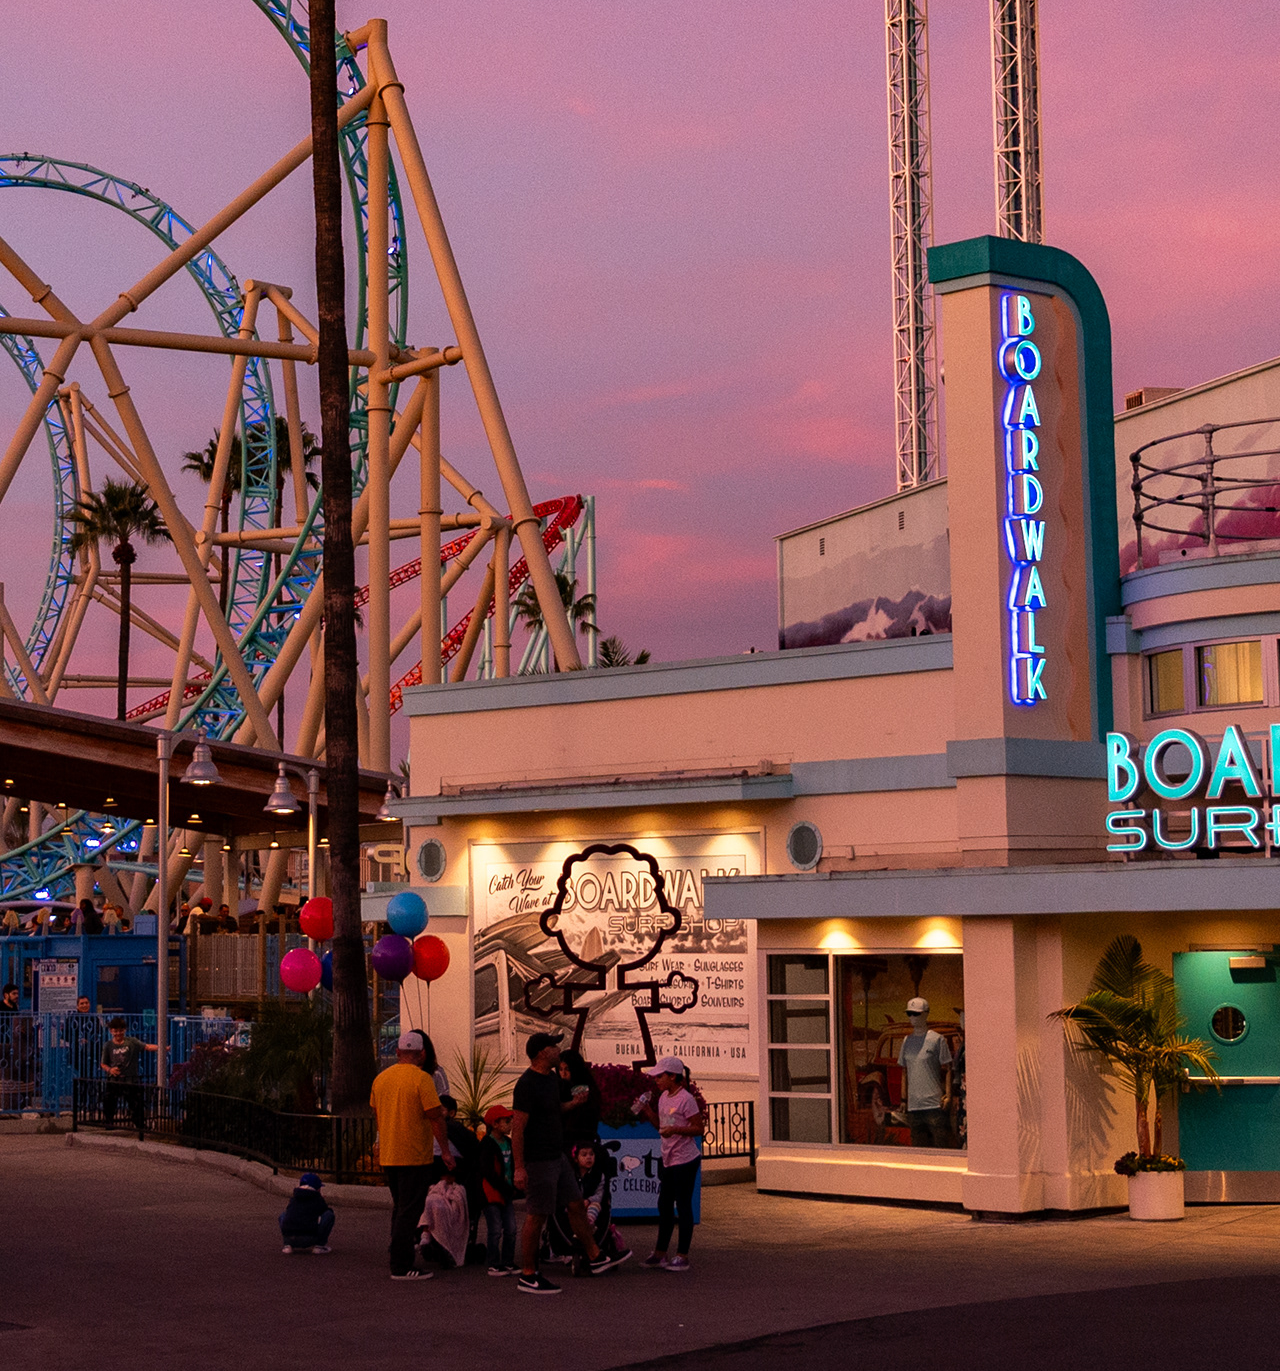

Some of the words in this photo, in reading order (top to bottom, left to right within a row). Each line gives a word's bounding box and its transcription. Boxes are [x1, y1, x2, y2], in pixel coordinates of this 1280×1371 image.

[1003, 295, 1048, 701] BOARDWALK
[488, 873, 515, 895] Catch
[515, 868, 545, 894] Your
[508, 893, 540, 913] Wave
[541, 891, 557, 907] at
[608, 915, 672, 936] SURF
[677, 916, 741, 935] SHOP
[693, 958, 745, 972] SUNGLASSES
[706, 976, 745, 991] T-SHIRTS
[631, 994, 654, 1007] BOAR
[700, 994, 745, 1008] SOUVENIRS
[615, 1043, 641, 1056] BUENA
[673, 1045, 721, 1058] CALIFORNIA
[730, 1047, 747, 1059] USA
